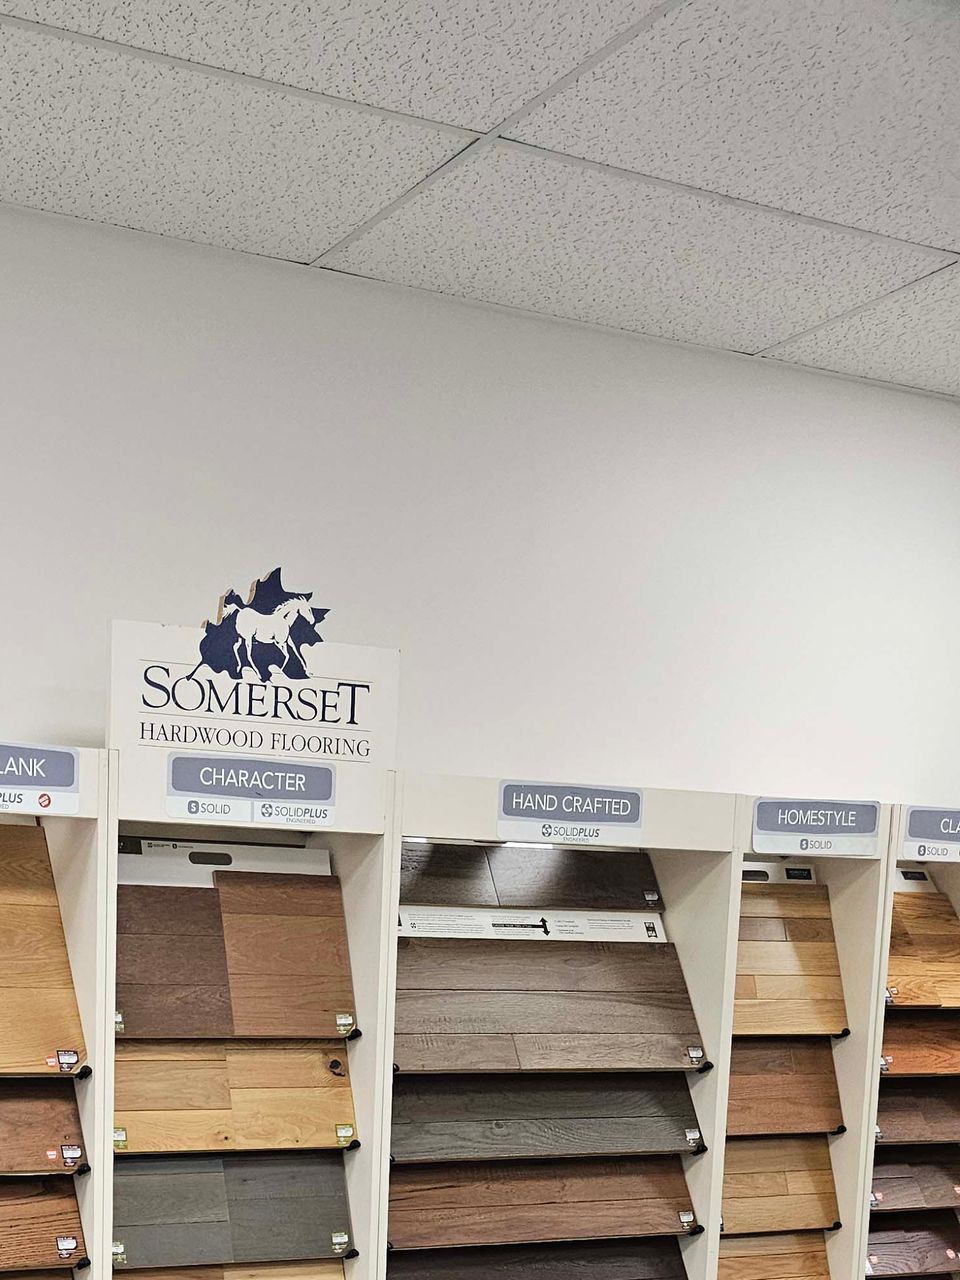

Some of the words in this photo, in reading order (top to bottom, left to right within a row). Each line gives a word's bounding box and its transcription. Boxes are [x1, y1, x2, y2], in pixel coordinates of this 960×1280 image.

[141, 665, 370, 726] SOMERSET
[139, 721, 263, 749] HARDWOOD
[271, 732, 370, 758] FLOORING
[200, 767, 306, 791] CHARACTER
[200, 802, 231, 815] SOLID
[512, 792, 558, 811] HAND
[562, 796, 631, 815] CRAFTED
[274, 806, 328, 819] SOLIDPLUS
[778, 808, 857, 827] HOMESTYLE
[553, 826, 600, 838] SOLIDPLUS
[809, 840, 832, 850] SOLID
[926, 847, 949, 856] SOLID
